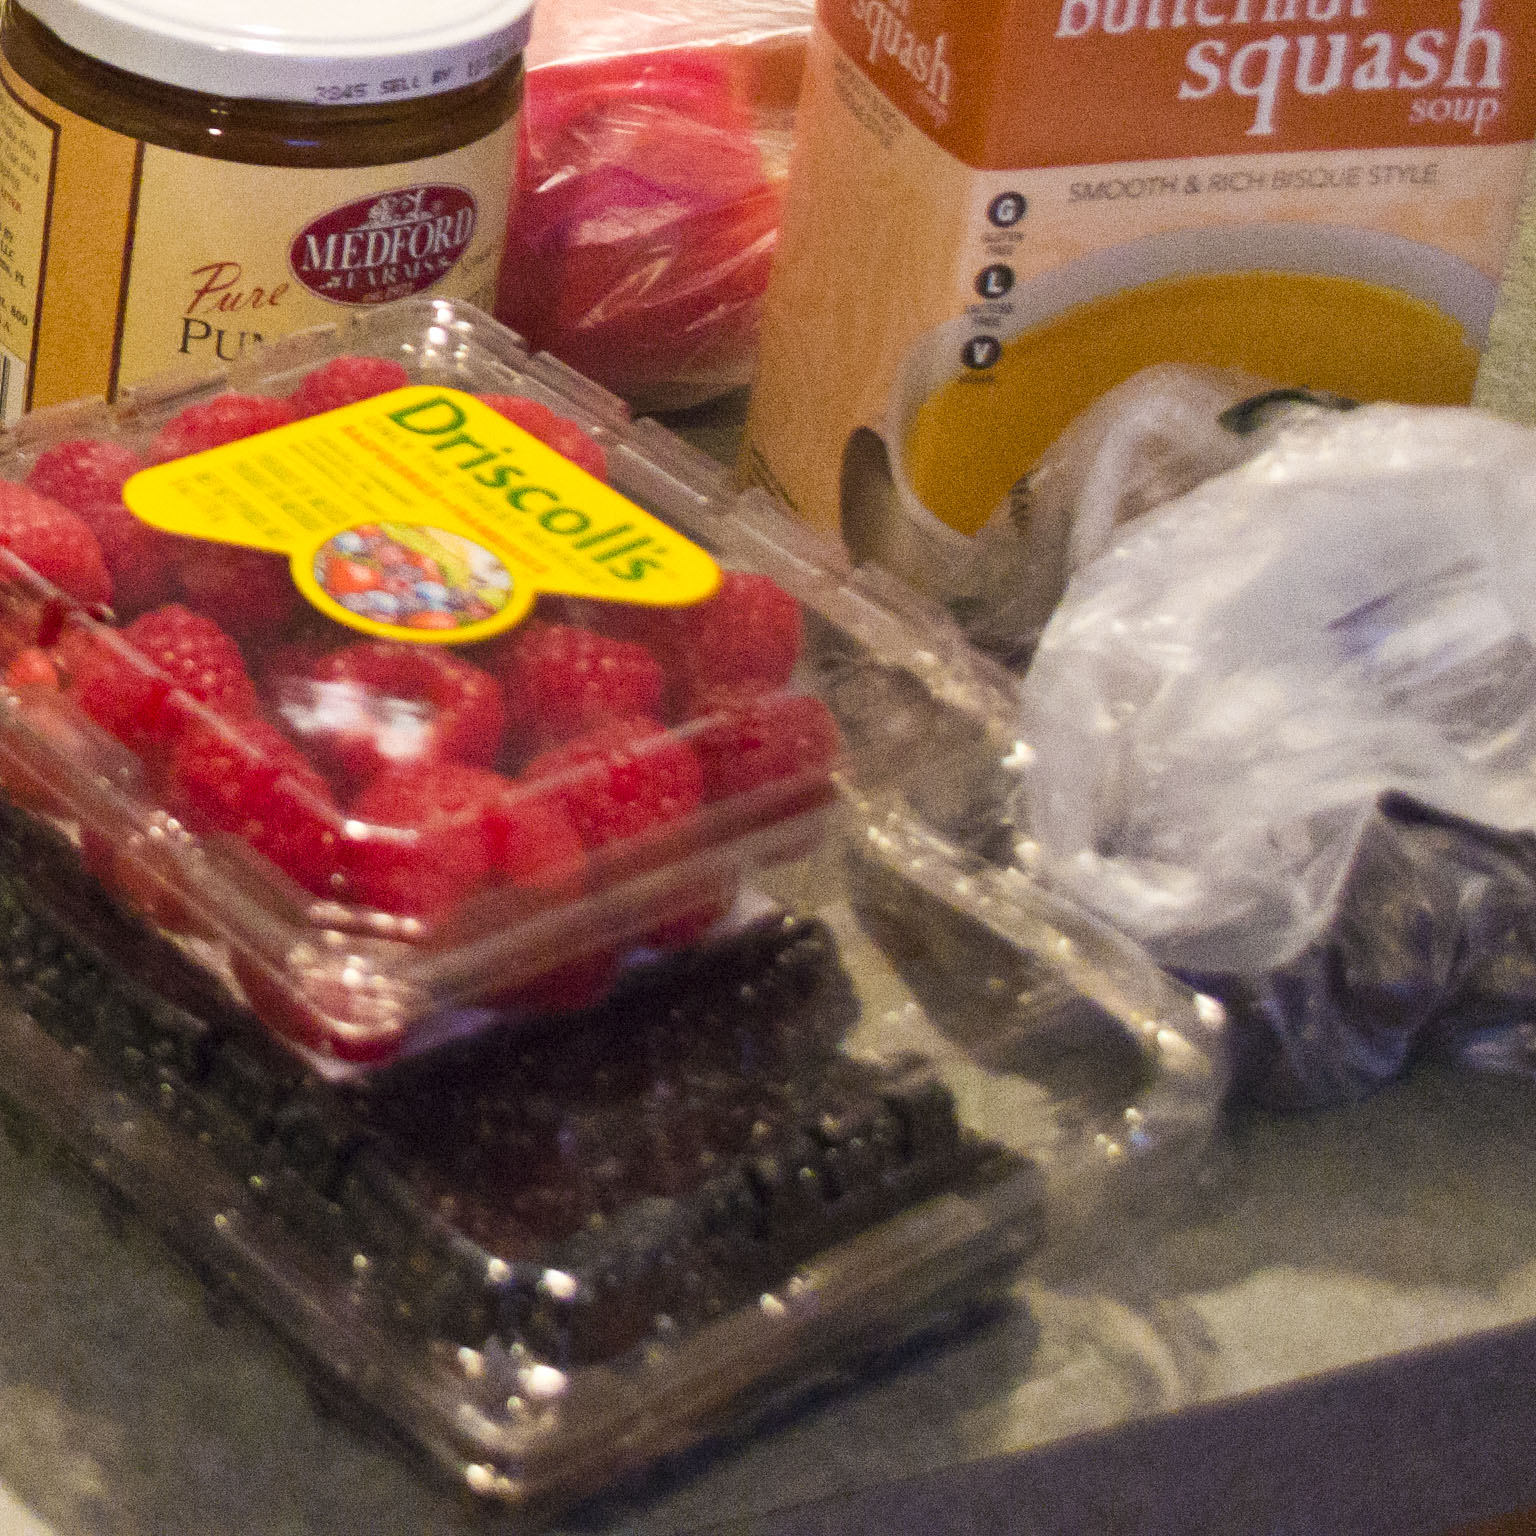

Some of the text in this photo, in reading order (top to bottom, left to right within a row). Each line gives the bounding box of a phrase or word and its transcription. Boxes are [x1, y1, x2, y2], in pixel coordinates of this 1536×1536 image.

[1409, 93, 1501, 135] soup
[1068, 162, 1441, 204] SMOOTH & RICH BISQUE STYLE
[997, 198, 1016, 222] G
[301, 205, 477, 273] MEDFORD
[188, 260, 290, 316] Pure
[386, 394, 671, 587] Driscoll's
